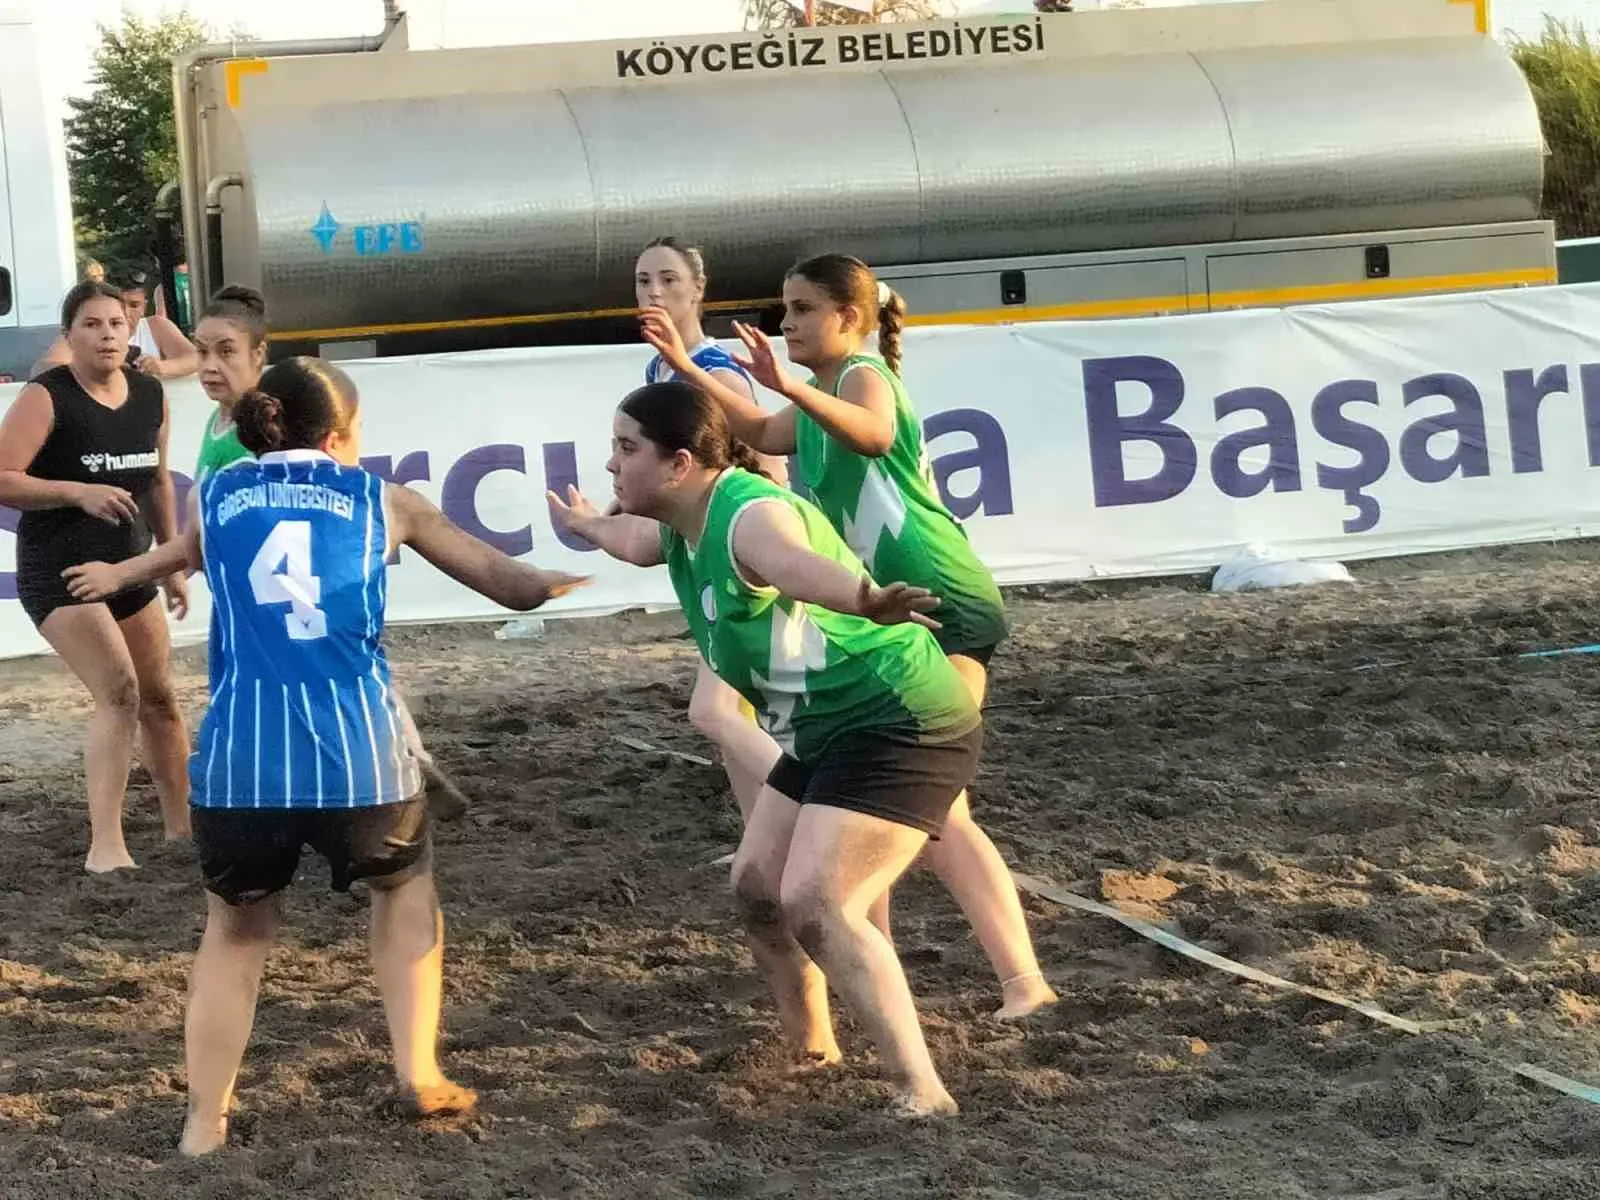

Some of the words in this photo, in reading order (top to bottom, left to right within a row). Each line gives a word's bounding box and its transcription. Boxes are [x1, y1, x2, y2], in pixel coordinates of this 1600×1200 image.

[616, 32, 826, 77] KÖYCEĞİZ
[838, 16, 1045, 63] BELEDİYESİ
[104, 448, 160, 471] hummel
[247, 519, 329, 640] 4
